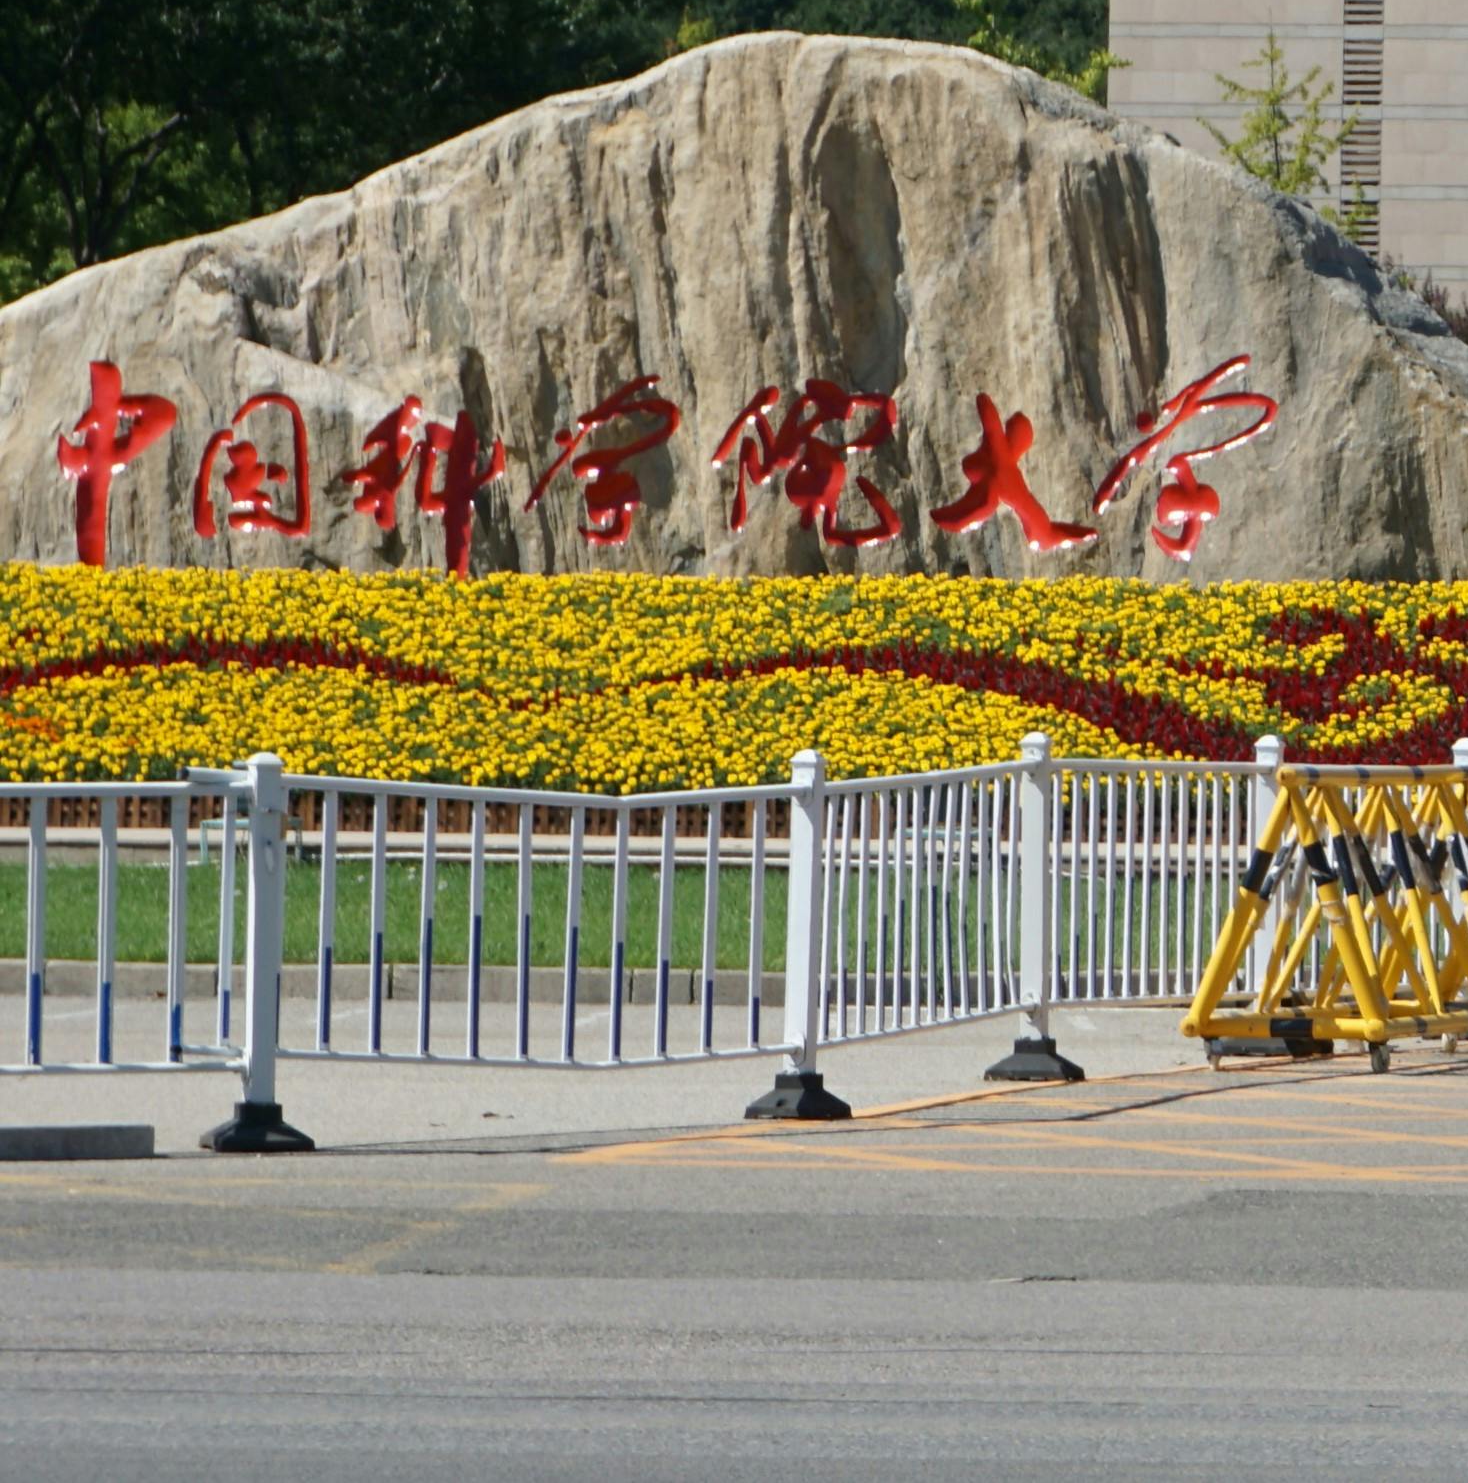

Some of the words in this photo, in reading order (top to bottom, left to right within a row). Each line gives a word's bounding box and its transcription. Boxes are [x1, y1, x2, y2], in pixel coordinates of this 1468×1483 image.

[57, 354, 1278, 581] 中国科学院大学
